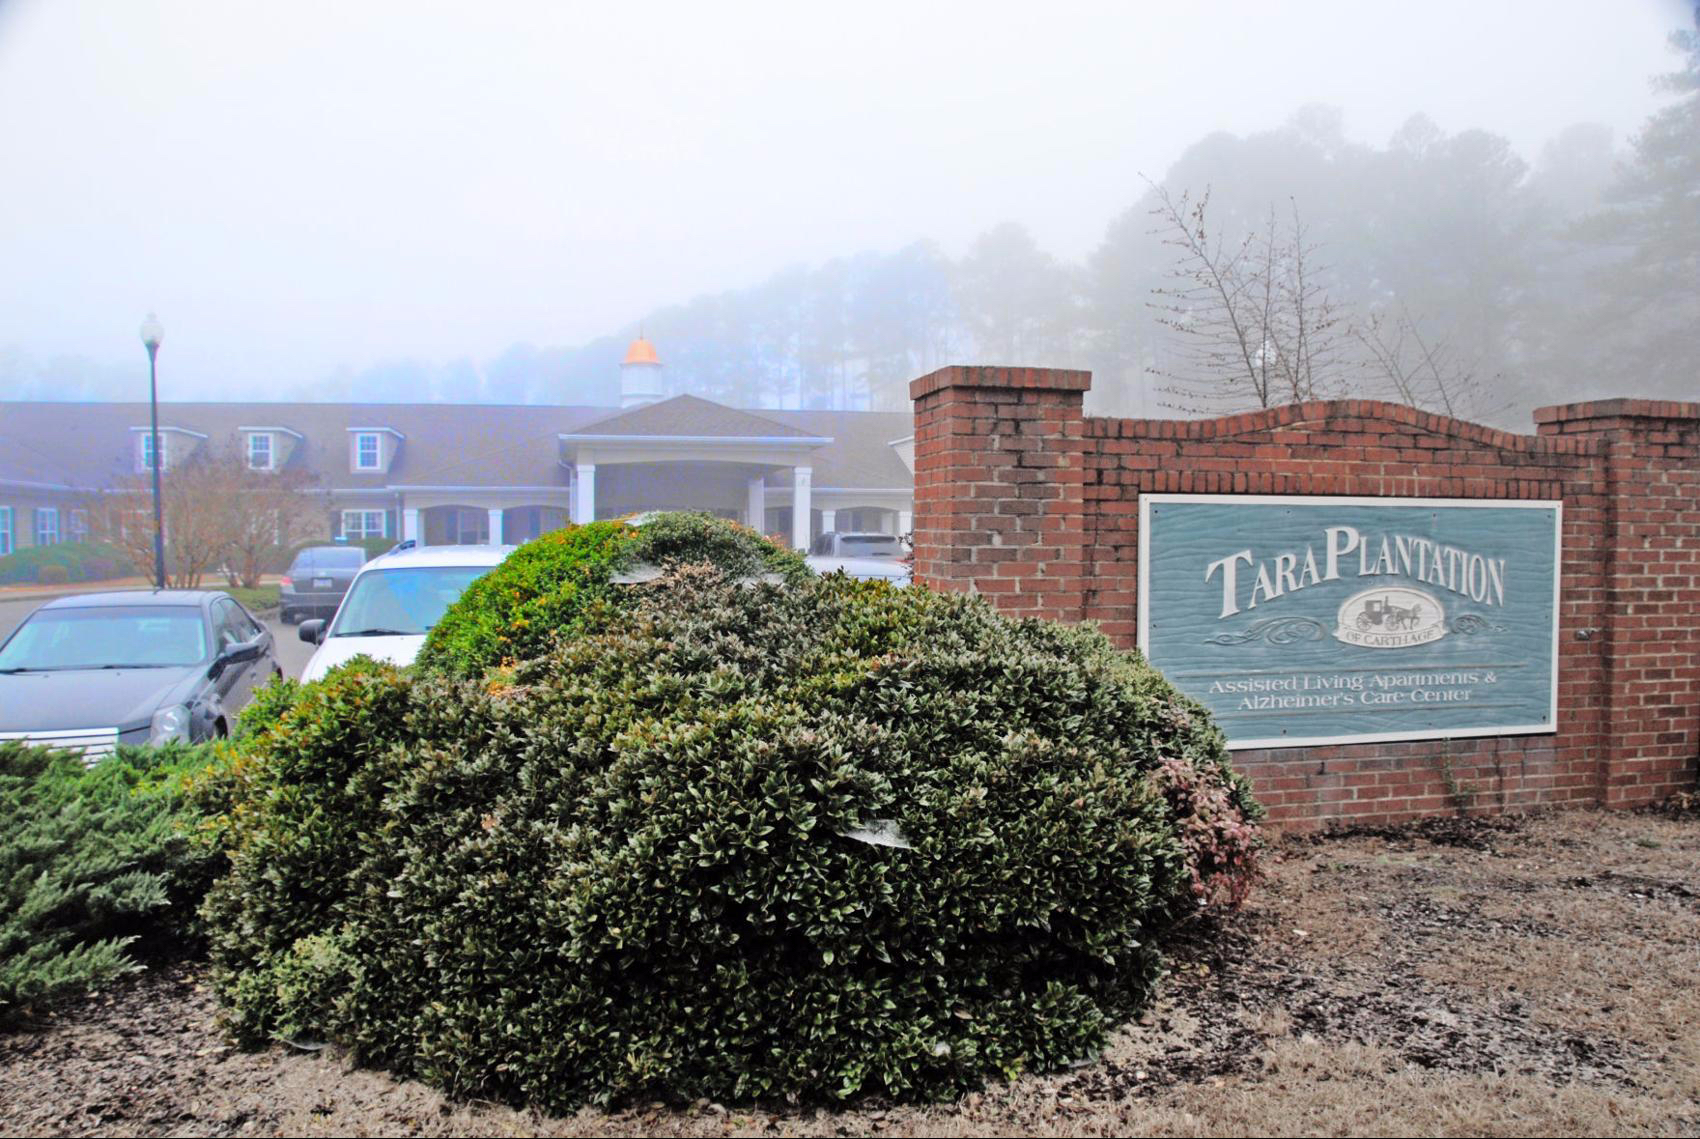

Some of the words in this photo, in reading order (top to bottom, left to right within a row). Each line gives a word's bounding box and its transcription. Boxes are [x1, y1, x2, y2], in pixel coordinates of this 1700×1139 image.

[1205, 545, 1322, 619] TARA
[1323, 526, 1506, 607] PLANTATION
[1345, 631, 1361, 642] OF
[1363, 629, 1435, 646] CARTHAGE
[1209, 675, 1297, 694] Assisted
[1304, 675, 1364, 692] Living
[1369, 671, 1479, 690] Apartments
[1484, 671, 1497, 684] &
[1238, 692, 1355, 711] Alzheimer's
[1360, 690, 1405, 705] Care
[1410, 688, 1472, 703] Center
